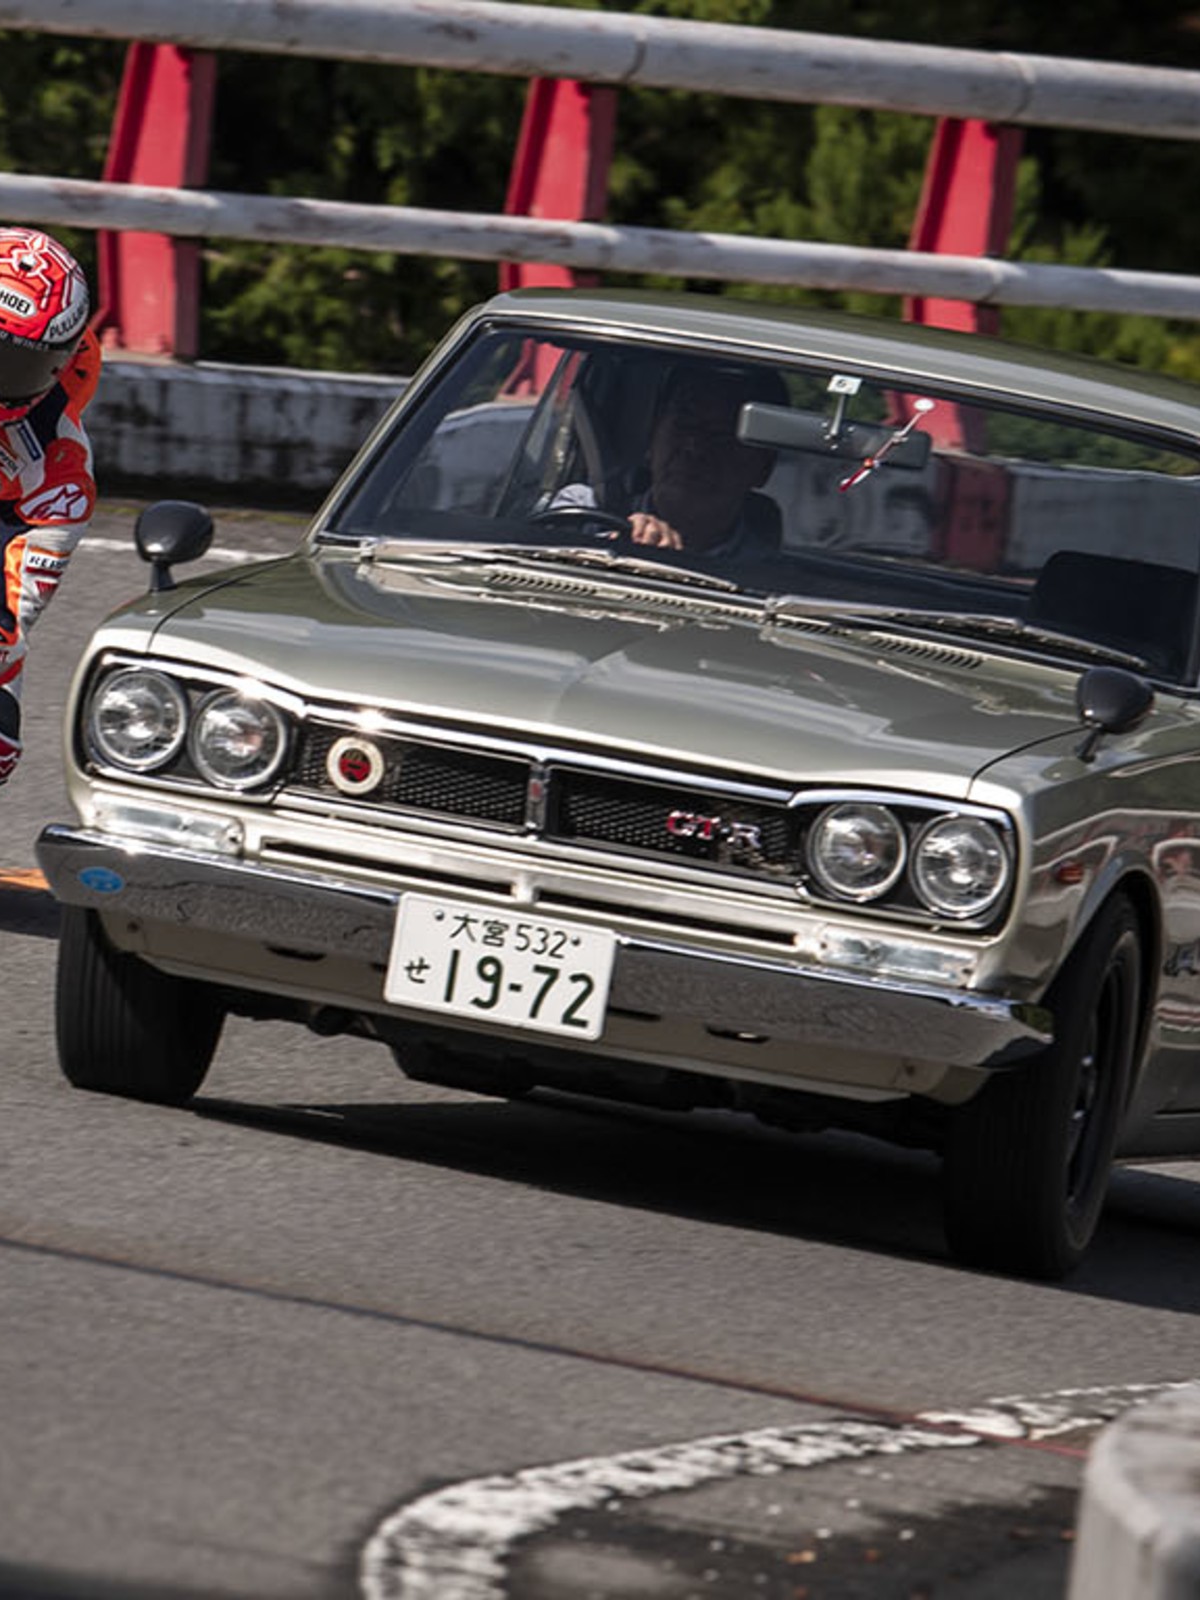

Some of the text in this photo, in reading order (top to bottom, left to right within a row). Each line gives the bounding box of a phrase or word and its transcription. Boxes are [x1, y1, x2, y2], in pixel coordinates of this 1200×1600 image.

[666, 809, 762, 848] GT-R
[404, 949, 595, 1029] せ 19-72
